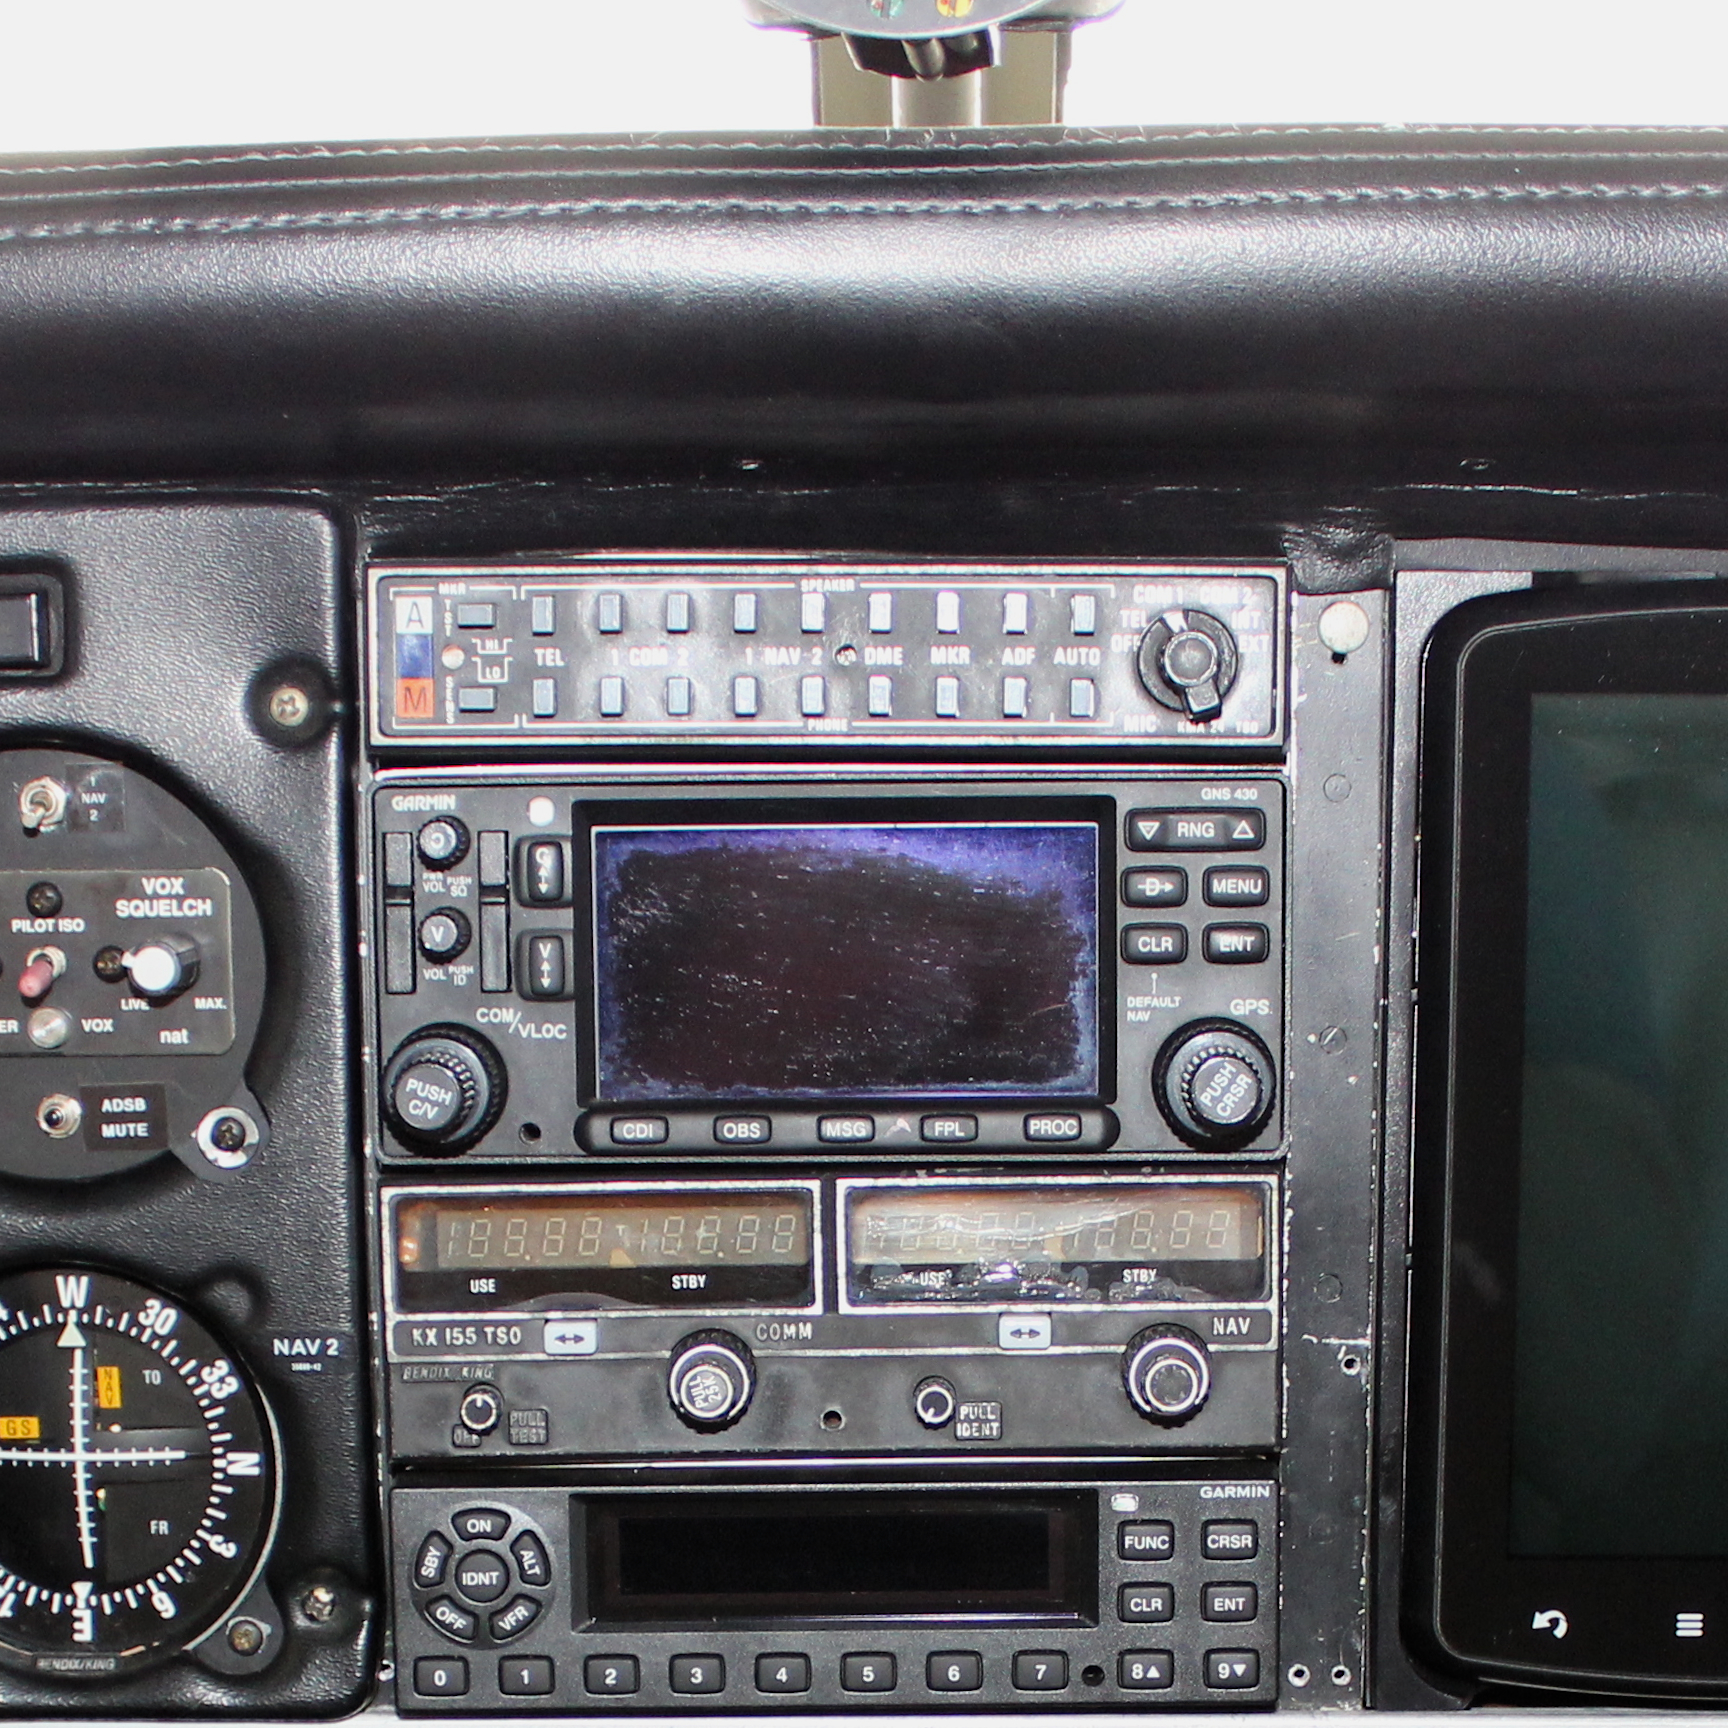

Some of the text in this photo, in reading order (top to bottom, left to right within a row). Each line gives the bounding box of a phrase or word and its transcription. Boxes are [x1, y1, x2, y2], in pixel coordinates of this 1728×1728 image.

[534, 646, 564, 667] TEL
[864, 646, 903, 666] DME
[930, 646, 970, 666] MKR
[1001, 646, 1036, 665] ADF
[1054, 646, 1101, 666] AUTO
[81, 791, 106, 806] NAV
[391, 794, 456, 811] GARMIN
[1201, 787, 1258, 801] GNS 430
[1177, 821, 1215, 838] RNG
[142, 876, 185, 896] VOX
[1212, 879, 1262, 895] MENU
[116, 897, 212, 918] SQUELCH
[11, 917, 85, 933] PILOT ISO
[1138, 936, 1173, 953] CLR
[1127, 996, 1181, 1008] DEFAULT
[1127, 1011, 1150, 1022] NAV
[81, 1018, 114, 1033] VOX
[160, 1027, 189, 1045] nat
[101, 1097, 146, 1113] ADSB
[101, 1121, 149, 1138] MUTE
[622, 1121, 654, 1140] CDI
[722, 1120, 761, 1140] OBS
[826, 1120, 867, 1140] MSG
[934, 1119, 965, 1139] FPL
[1029, 1117, 1077, 1137] PROC
[470, 1279, 495, 1294] USE
[672, 1275, 706, 1290] STBY
[139, 1298, 177, 1336] 30
[756, 1323, 812, 1341] COMM
[1213, 1316, 1250, 1336] NAV
[412, 1327, 521, 1346] KX 155 TSO
[273, 1338, 339, 1356] NAV 2
[143, 1369, 161, 1386] TO
[1200, 1486, 1270, 1499] GARMIN
[150, 1520, 169, 1535] FR
[467, 1518, 492, 1534] ON
[1125, 1534, 1169, 1551] FUNC
[1208, 1533, 1252, 1550] CRSR
[462, 1570, 499, 1586] IDNT
[1130, 1596, 1162, 1614] CLR
[1214, 1596, 1245, 1613] ENT
